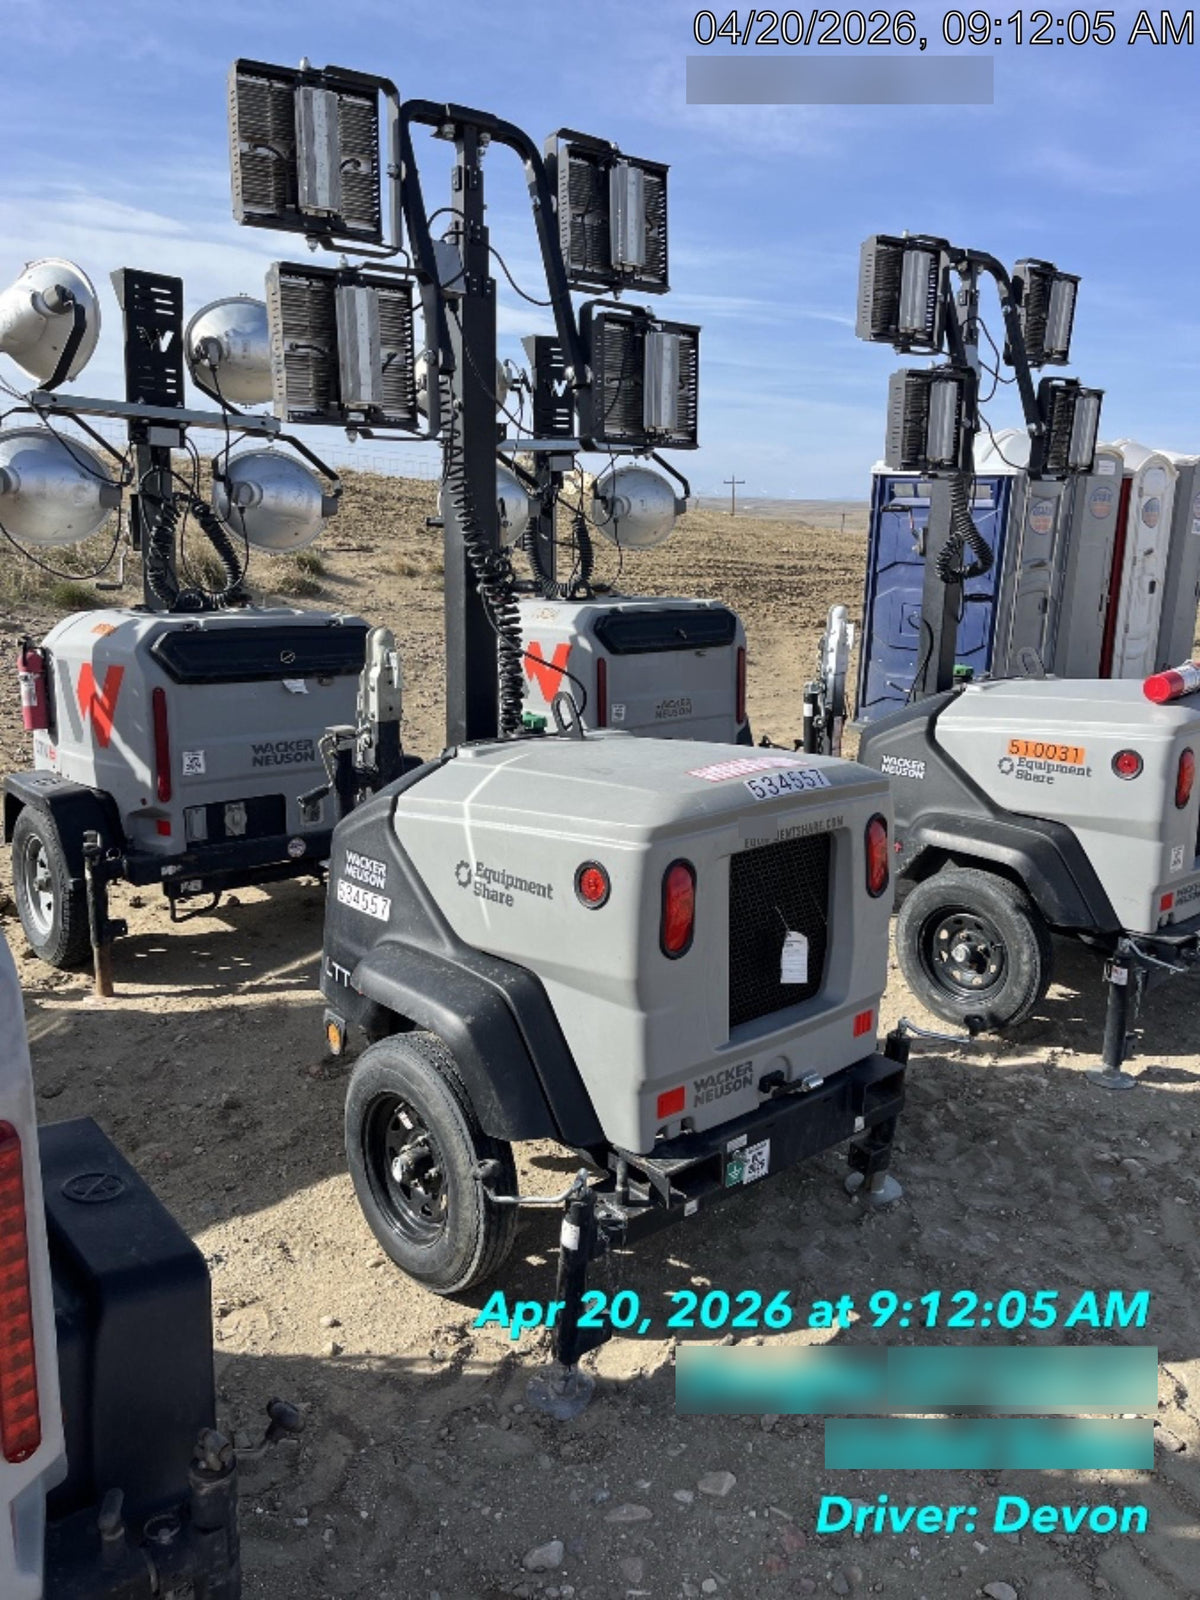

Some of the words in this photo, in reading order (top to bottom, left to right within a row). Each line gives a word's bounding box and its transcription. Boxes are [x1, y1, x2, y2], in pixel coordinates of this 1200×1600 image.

[251, 739, 314, 755] WACKER
[252, 749, 315, 767] NEUSON
[1009, 740, 1080, 763] 510031
[881, 764, 925, 780] NEUSON
[882, 754, 926, 771] WACKER
[1017, 757, 1092, 777] Equipment
[747, 769, 824, 799] 534557
[1015, 769, 1055, 785] Share
[345, 850, 387, 877] WACKER
[344, 864, 386, 890] NEUSON
[475, 861, 554, 900] Equipment
[338, 880, 389, 918] 534557
[473, 881, 515, 908] Share
[693, 1061, 753, 1094] WACKER
[694, 1074, 753, 1108] NEUSON
